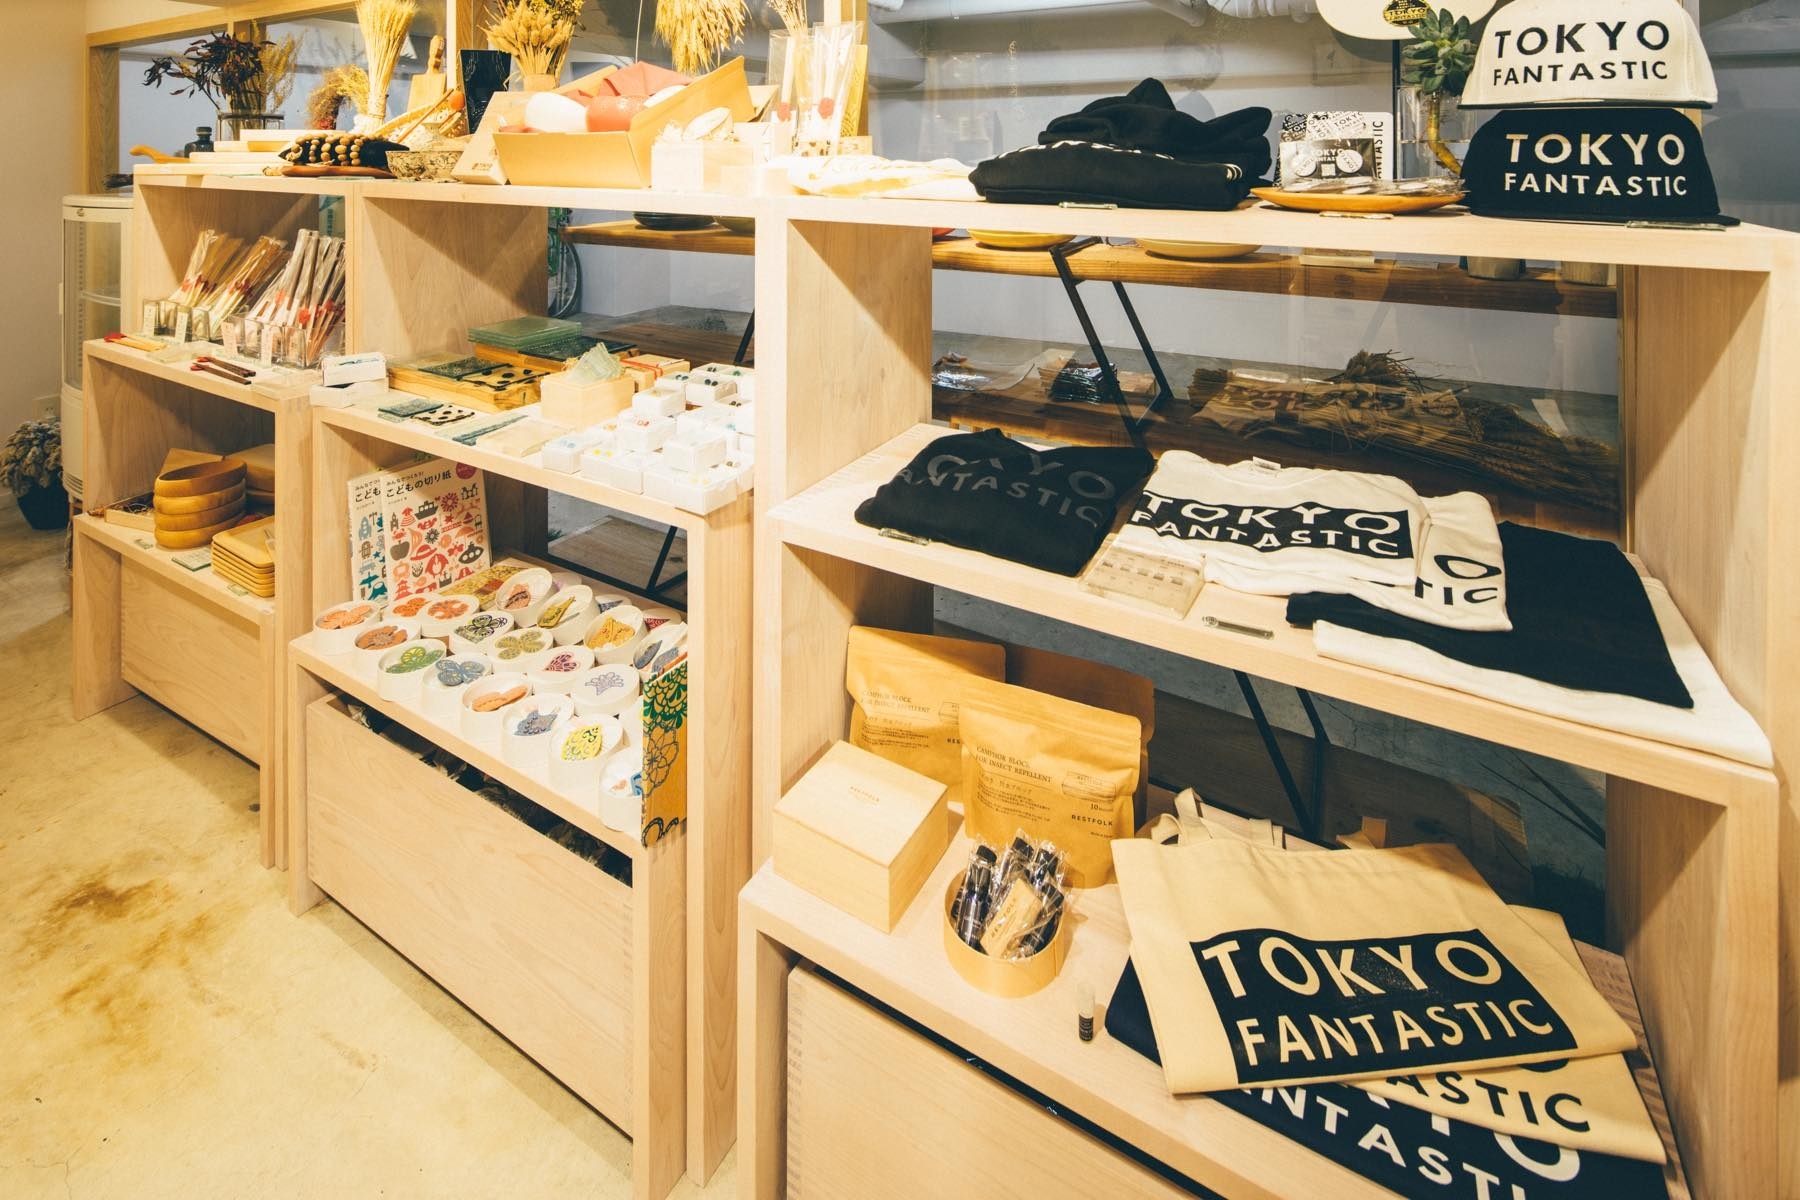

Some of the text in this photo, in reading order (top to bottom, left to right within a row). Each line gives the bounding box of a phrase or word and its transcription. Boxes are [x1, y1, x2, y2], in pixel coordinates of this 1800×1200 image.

[1494, 20, 1670, 59] TOKYO
[1493, 61, 1668, 86] FANTASTIC
[1505, 133, 1685, 166] TOKYO
[1504, 172, 1687, 197] FANTASTIC
[386, 470, 452, 498] こどもの切り紙
[1142, 491, 1401, 536] TOKYO
[1132, 511, 1400, 557] FANTASTIC
[976, 747, 1006, 762] CAMPHOR
[989, 760, 1012, 772] INSECT
[1014, 768, 1053, 783] REPELLENT
[1201, 937, 1503, 998] TOKYO
[1236, 999, 1554, 1067] FANTASTIC
